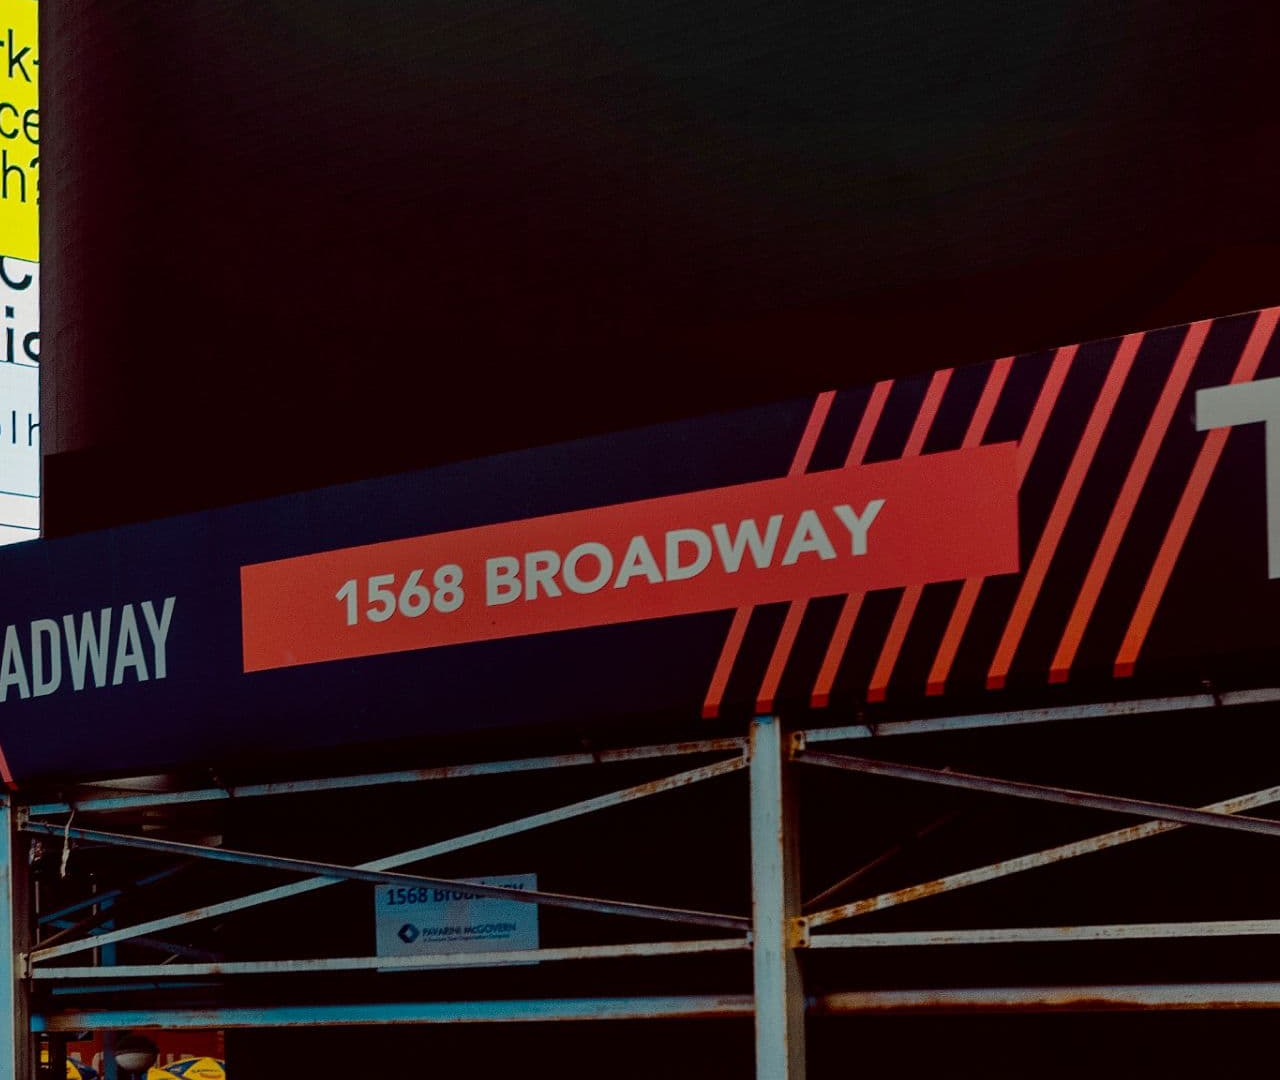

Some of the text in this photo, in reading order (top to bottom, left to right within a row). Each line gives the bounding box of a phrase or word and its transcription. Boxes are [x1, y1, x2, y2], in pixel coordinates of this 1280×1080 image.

[334, 499, 886, 627] 1568 BROADWAY
[387, 888, 428, 905] 1568
